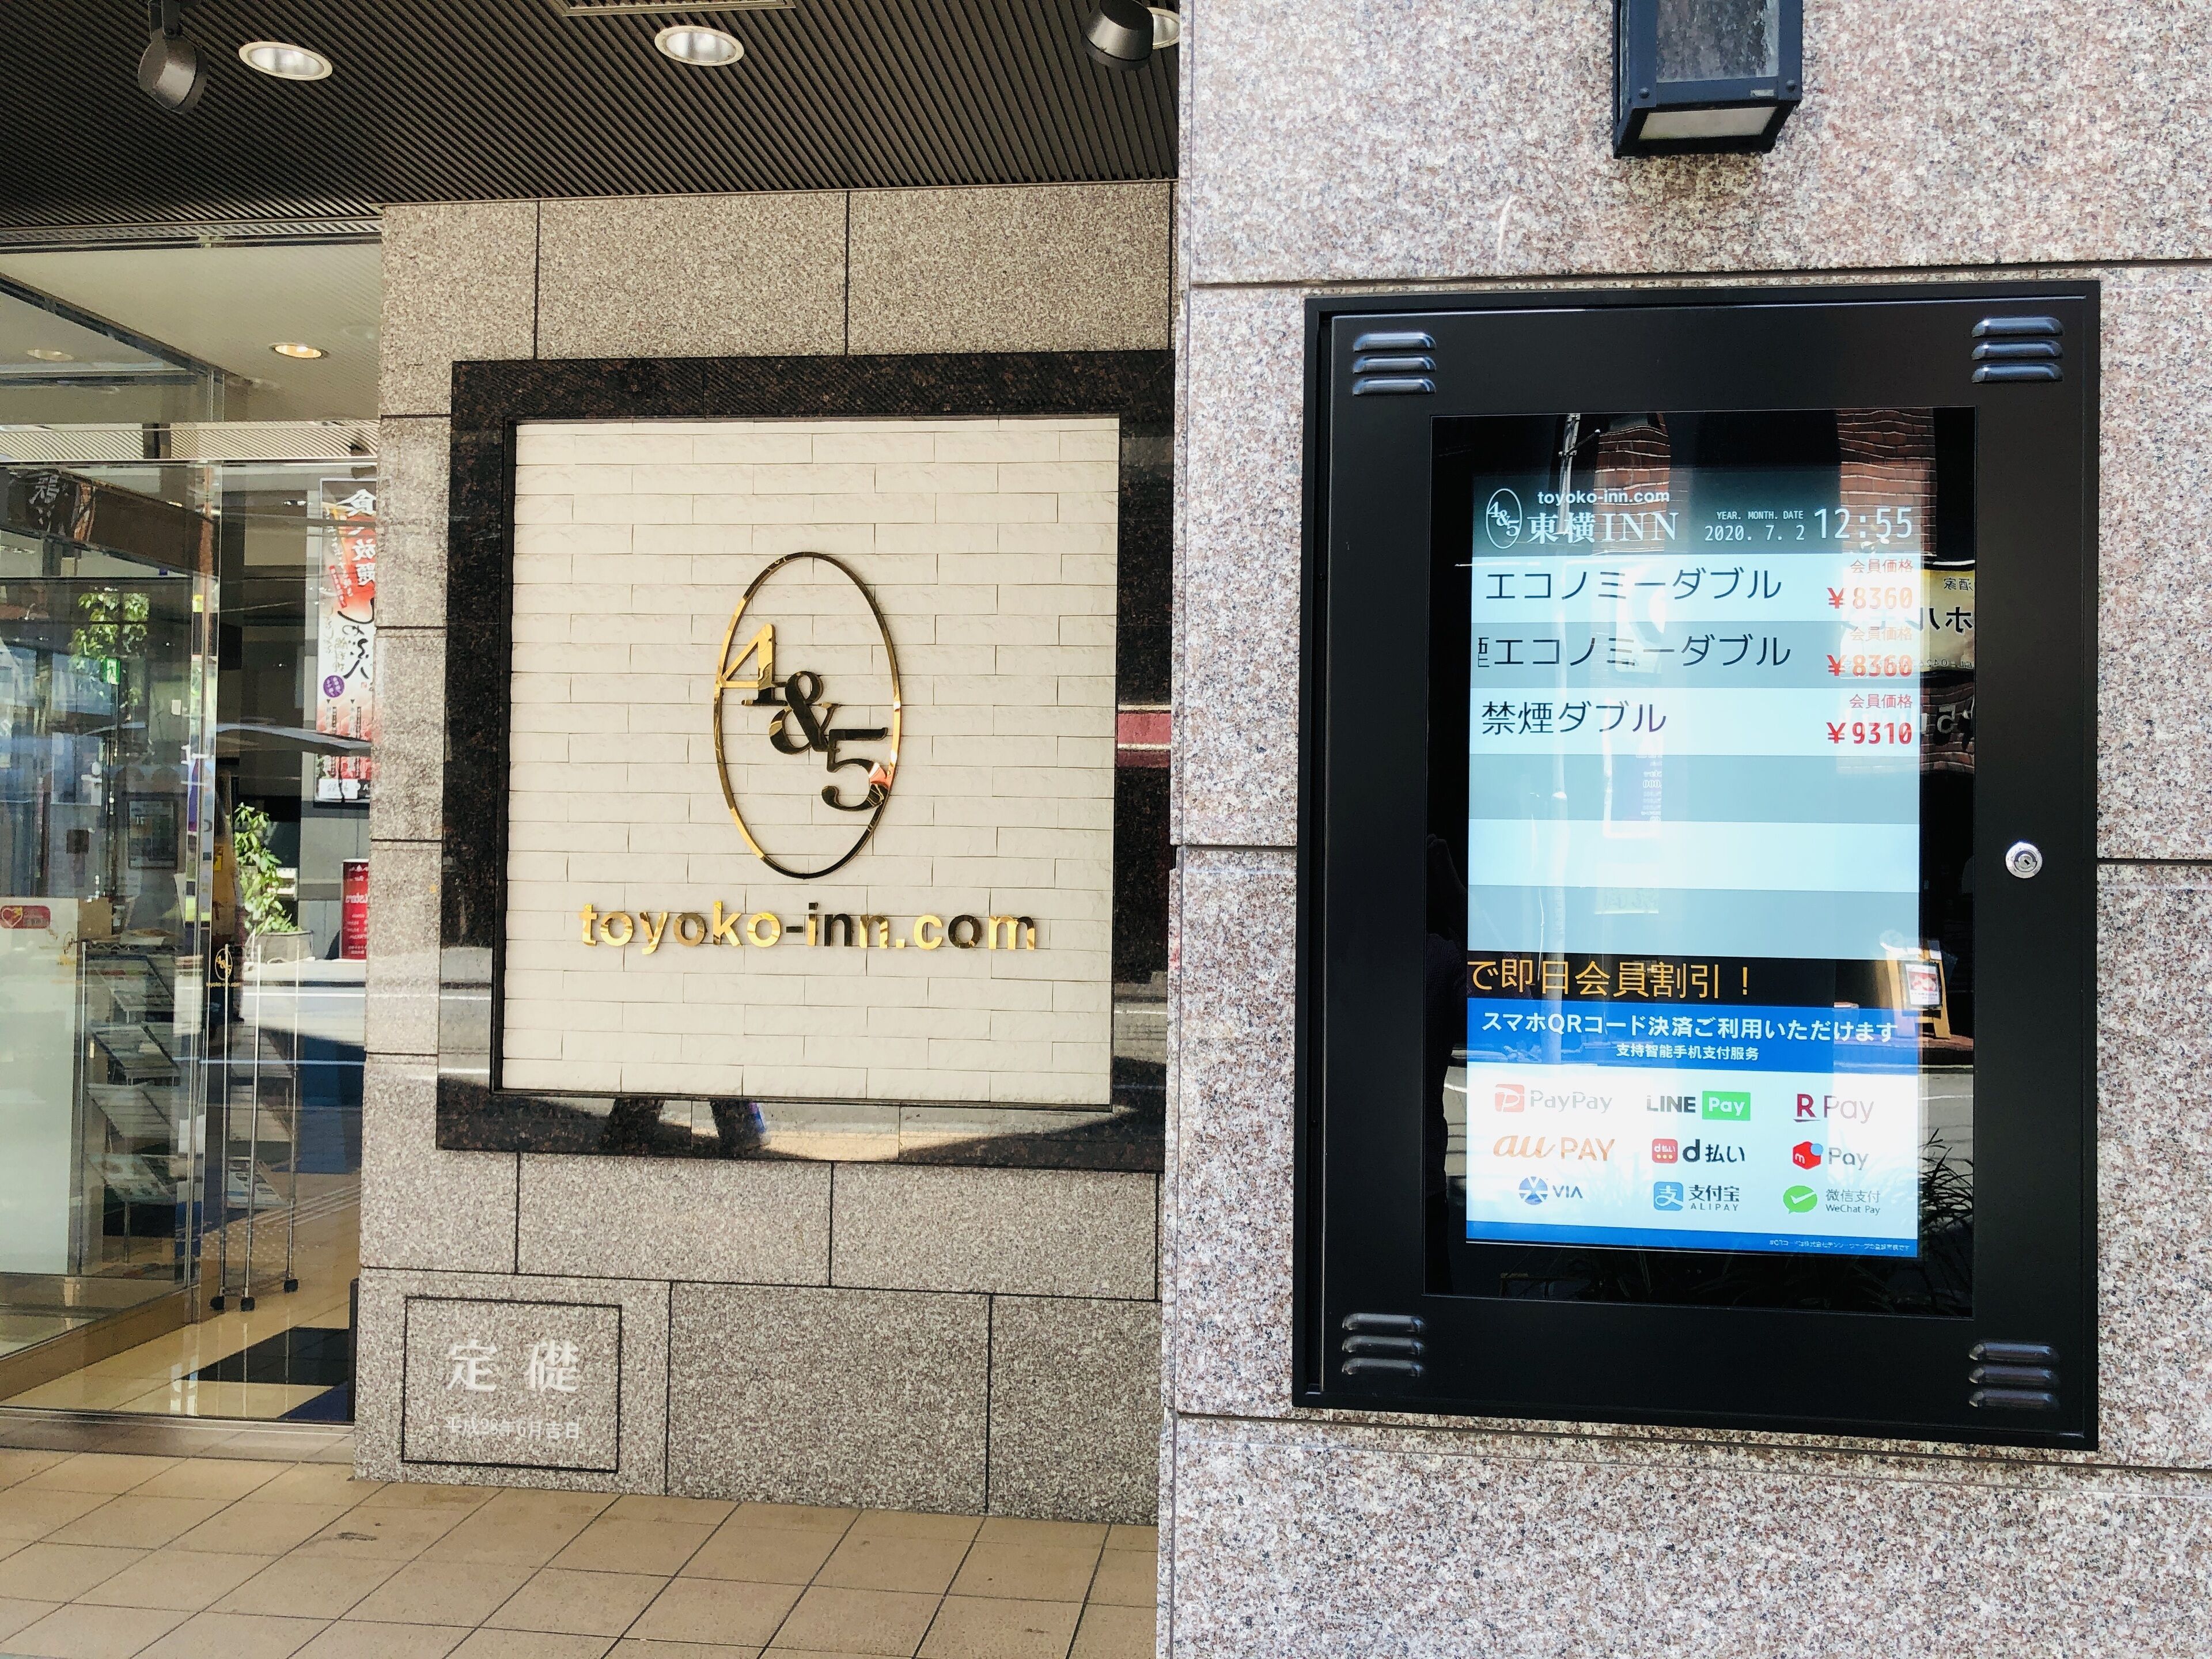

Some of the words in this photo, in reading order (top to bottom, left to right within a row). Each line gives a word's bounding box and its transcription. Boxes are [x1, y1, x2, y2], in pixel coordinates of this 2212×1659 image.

[1537, 490, 1669, 507] toyoko-inn.com
[1487, 501, 1520, 537] 4&5
[1717, 511, 1741, 520] YEAR.
[1748, 510, 1778, 520] MONTH.
[1783, 510, 1804, 520] DATE
[1815, 507, 1912, 539] 12:55
[1527, 512, 1679, 544] 東横INN
[1850, 559, 1914, 574] 会員価格
[1486, 567, 1782, 600] エコノミーダブル
[1850, 626, 1912, 641] 会員価格
[1850, 694, 1913, 709] 会員価格
[718, 624, 889, 812] 4&5
[1481, 700, 1666, 736] 禁煙ダブル
[1827, 722, 1912, 744] ¥9310
[579, 900, 1036, 955] toyoko-inn.com
[1482, 1012, 1898, 1043] スマホQRコード決済ご利用いただけます
[1616, 1043, 1759, 1061] 支持智能手机支付服务
[1530, 1090, 1612, 1113] PayPay
[1646, 1095, 1696, 1113] LINE
[1709, 1097, 1745, 1116] Pay
[1824, 1096, 1874, 1123] Pay
[1493, 1135, 1555, 1158] au
[1561, 1137, 1615, 1161] PAY
[1828, 1147, 1869, 1170] Pay
[1552, 1185, 1583, 1199] VIA
[1688, 1184, 1740, 1202] 支付宝
[1825, 1189, 1881, 1203] 微信支付
[1691, 1203, 1738, 1211] ALIPAY
[1825, 1205, 1861, 1213] WeChat
[1865, 1206, 1880, 1215] Pay
[443, 1416, 580, 1440] 平成28年6月吉日
